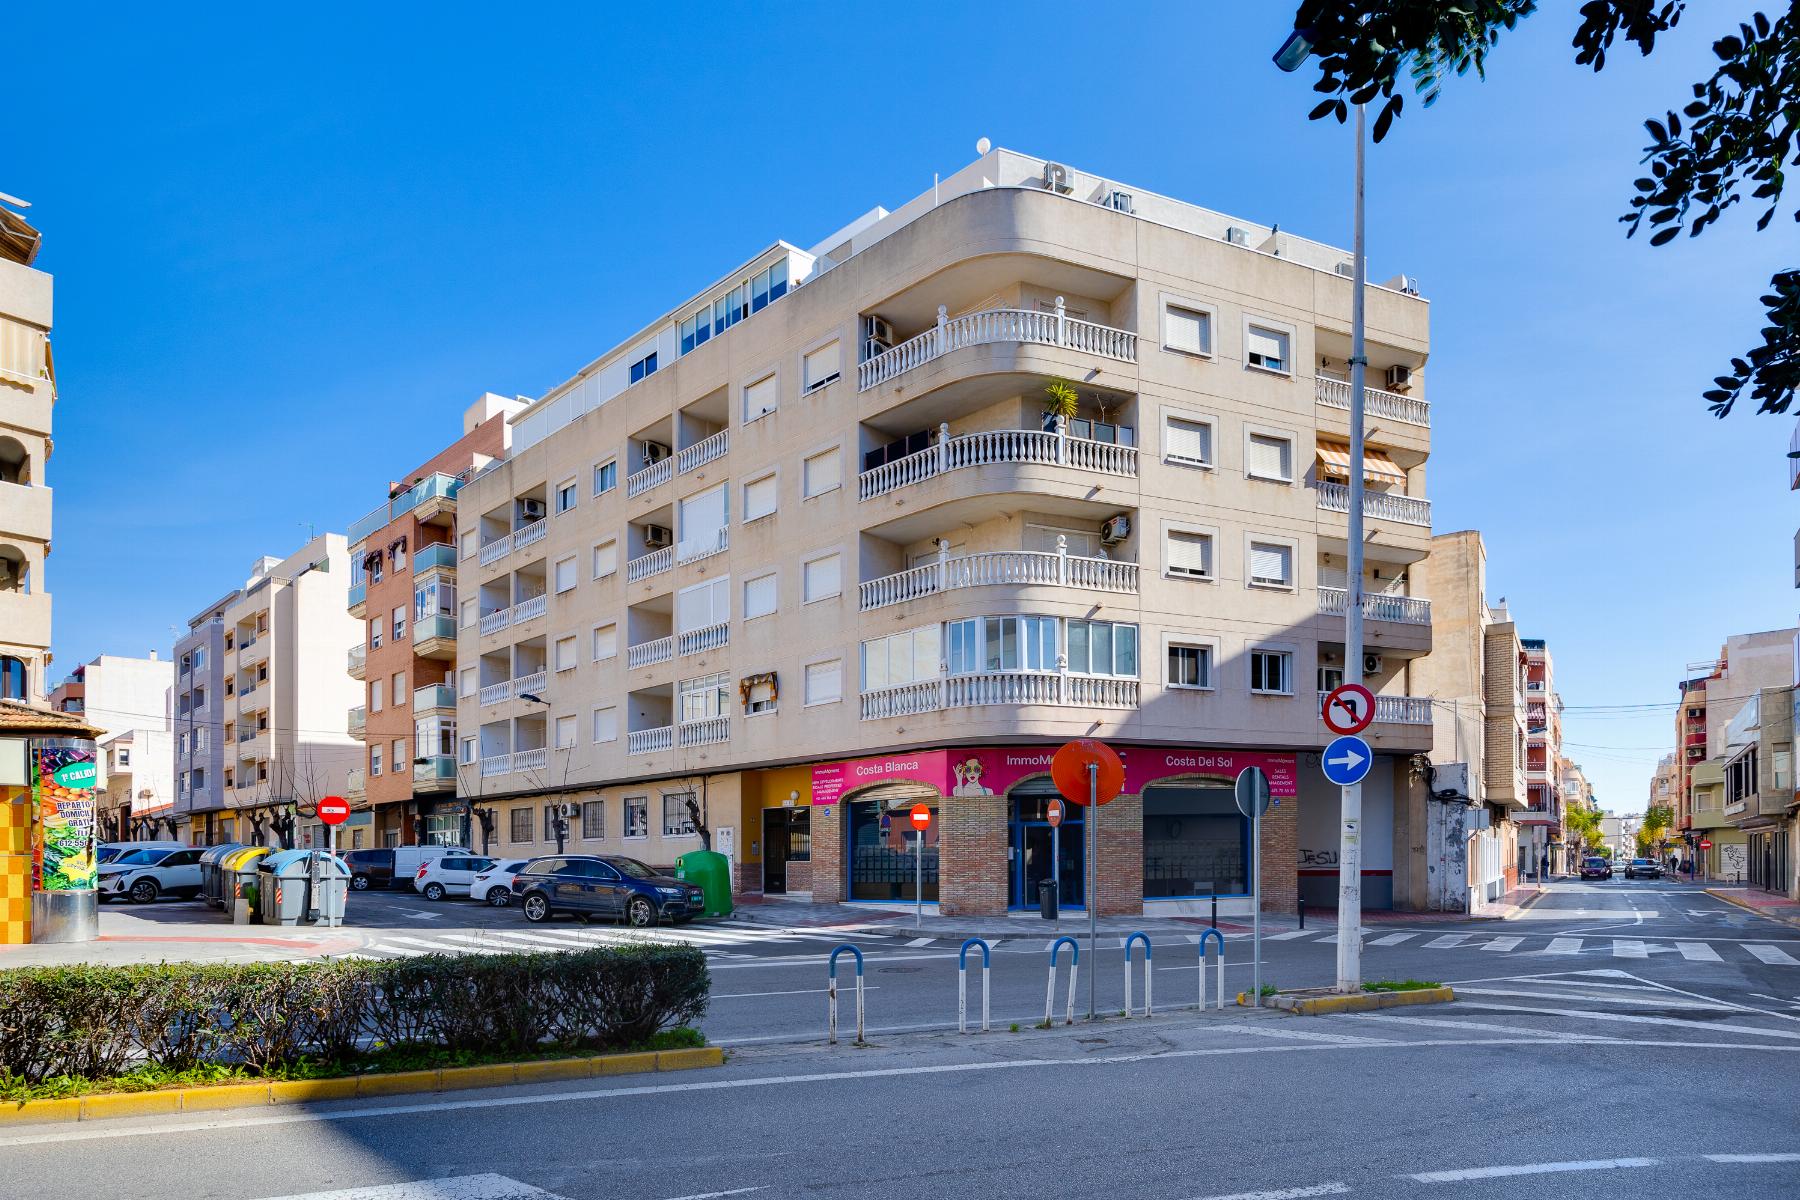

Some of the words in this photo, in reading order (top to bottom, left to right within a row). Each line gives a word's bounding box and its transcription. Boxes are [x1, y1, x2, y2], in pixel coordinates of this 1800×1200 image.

[1166, 755, 1196, 767] Costa
[1198, 756, 1215, 767] Del
[1217, 757, 1233, 768] Sol
[856, 764, 883, 776] Costa
[885, 761, 919, 773] Blanca
[57, 801, 90, 810] REPARTO
